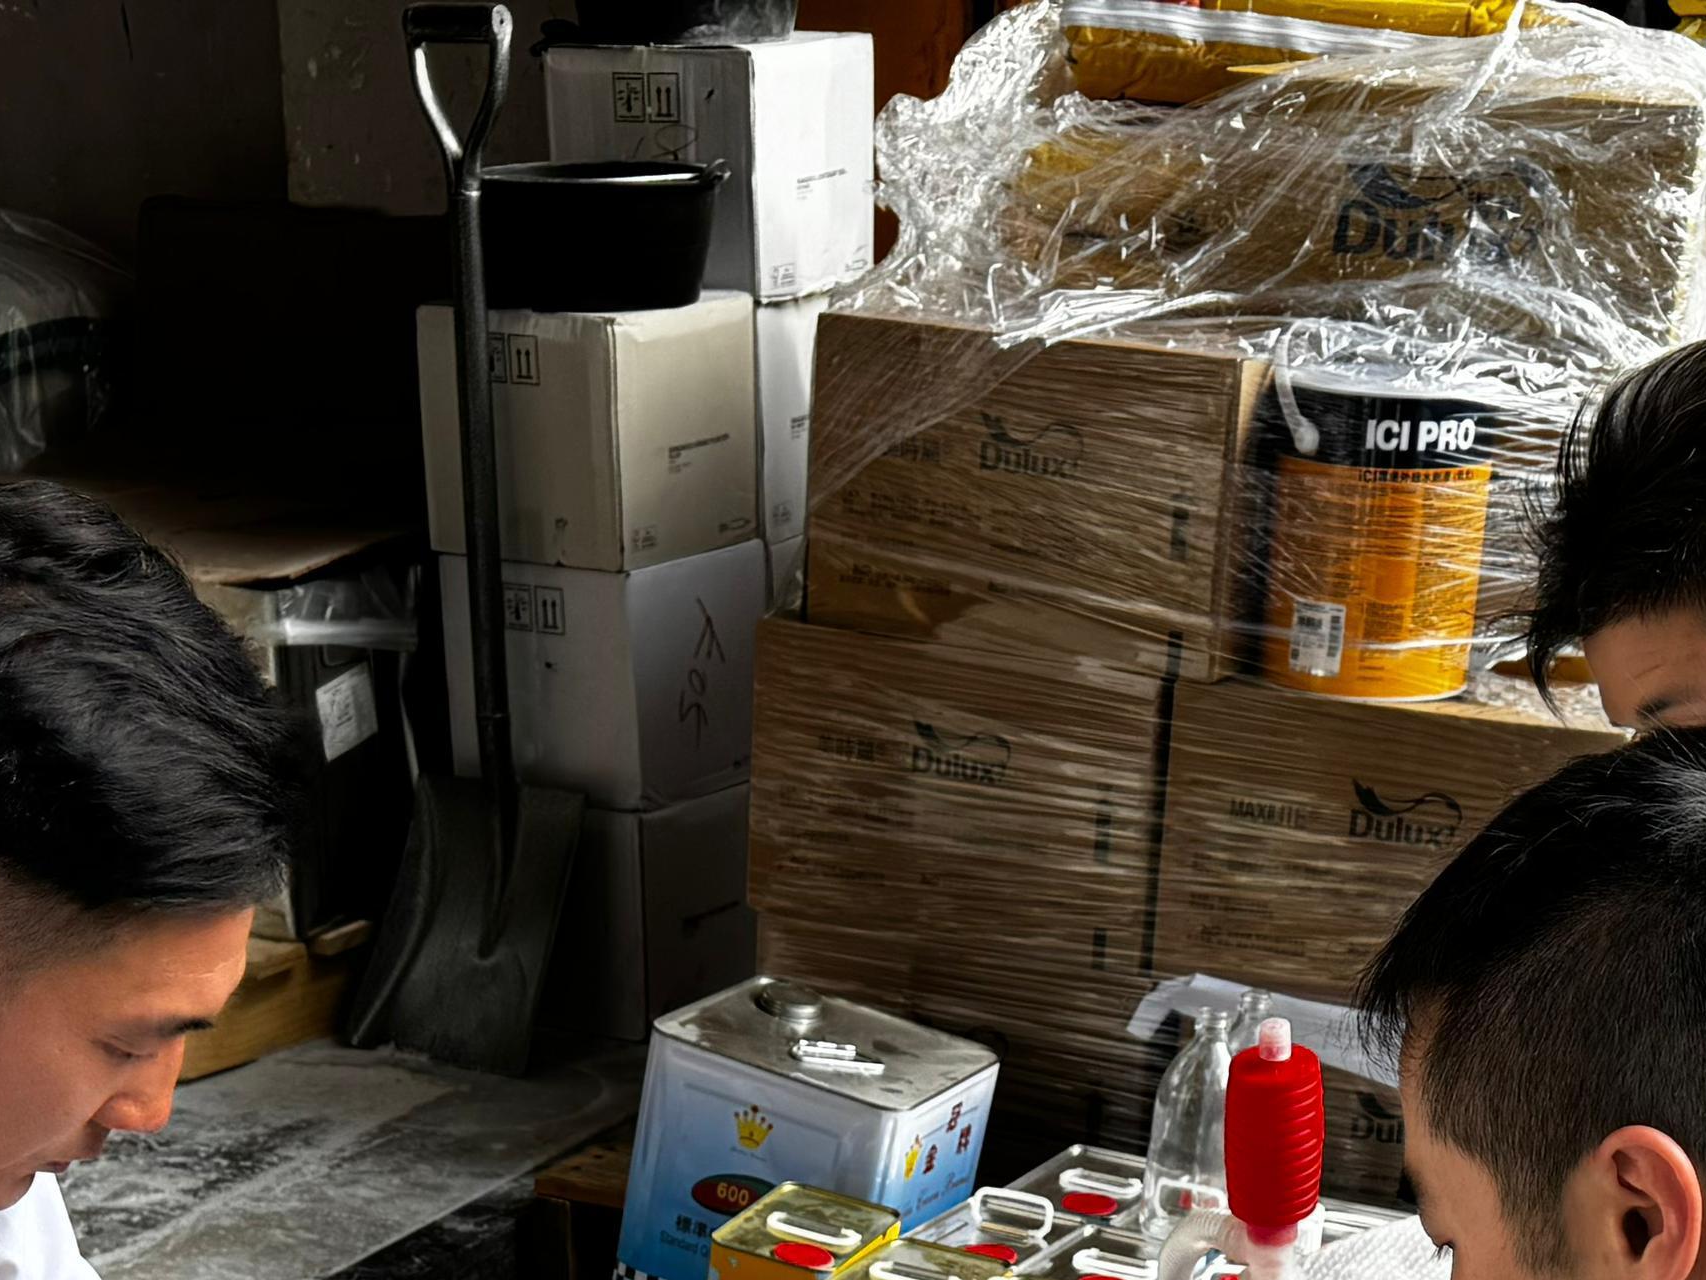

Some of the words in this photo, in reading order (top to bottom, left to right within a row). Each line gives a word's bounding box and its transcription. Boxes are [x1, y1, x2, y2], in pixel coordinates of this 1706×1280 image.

[1365, 419, 1411, 451] ICI
[1417, 418, 1477, 451] PRO
[978, 438, 1080, 480] Dulux
[1348, 808, 1456, 850] Dulux
[716, 1182, 750, 1207] 600
